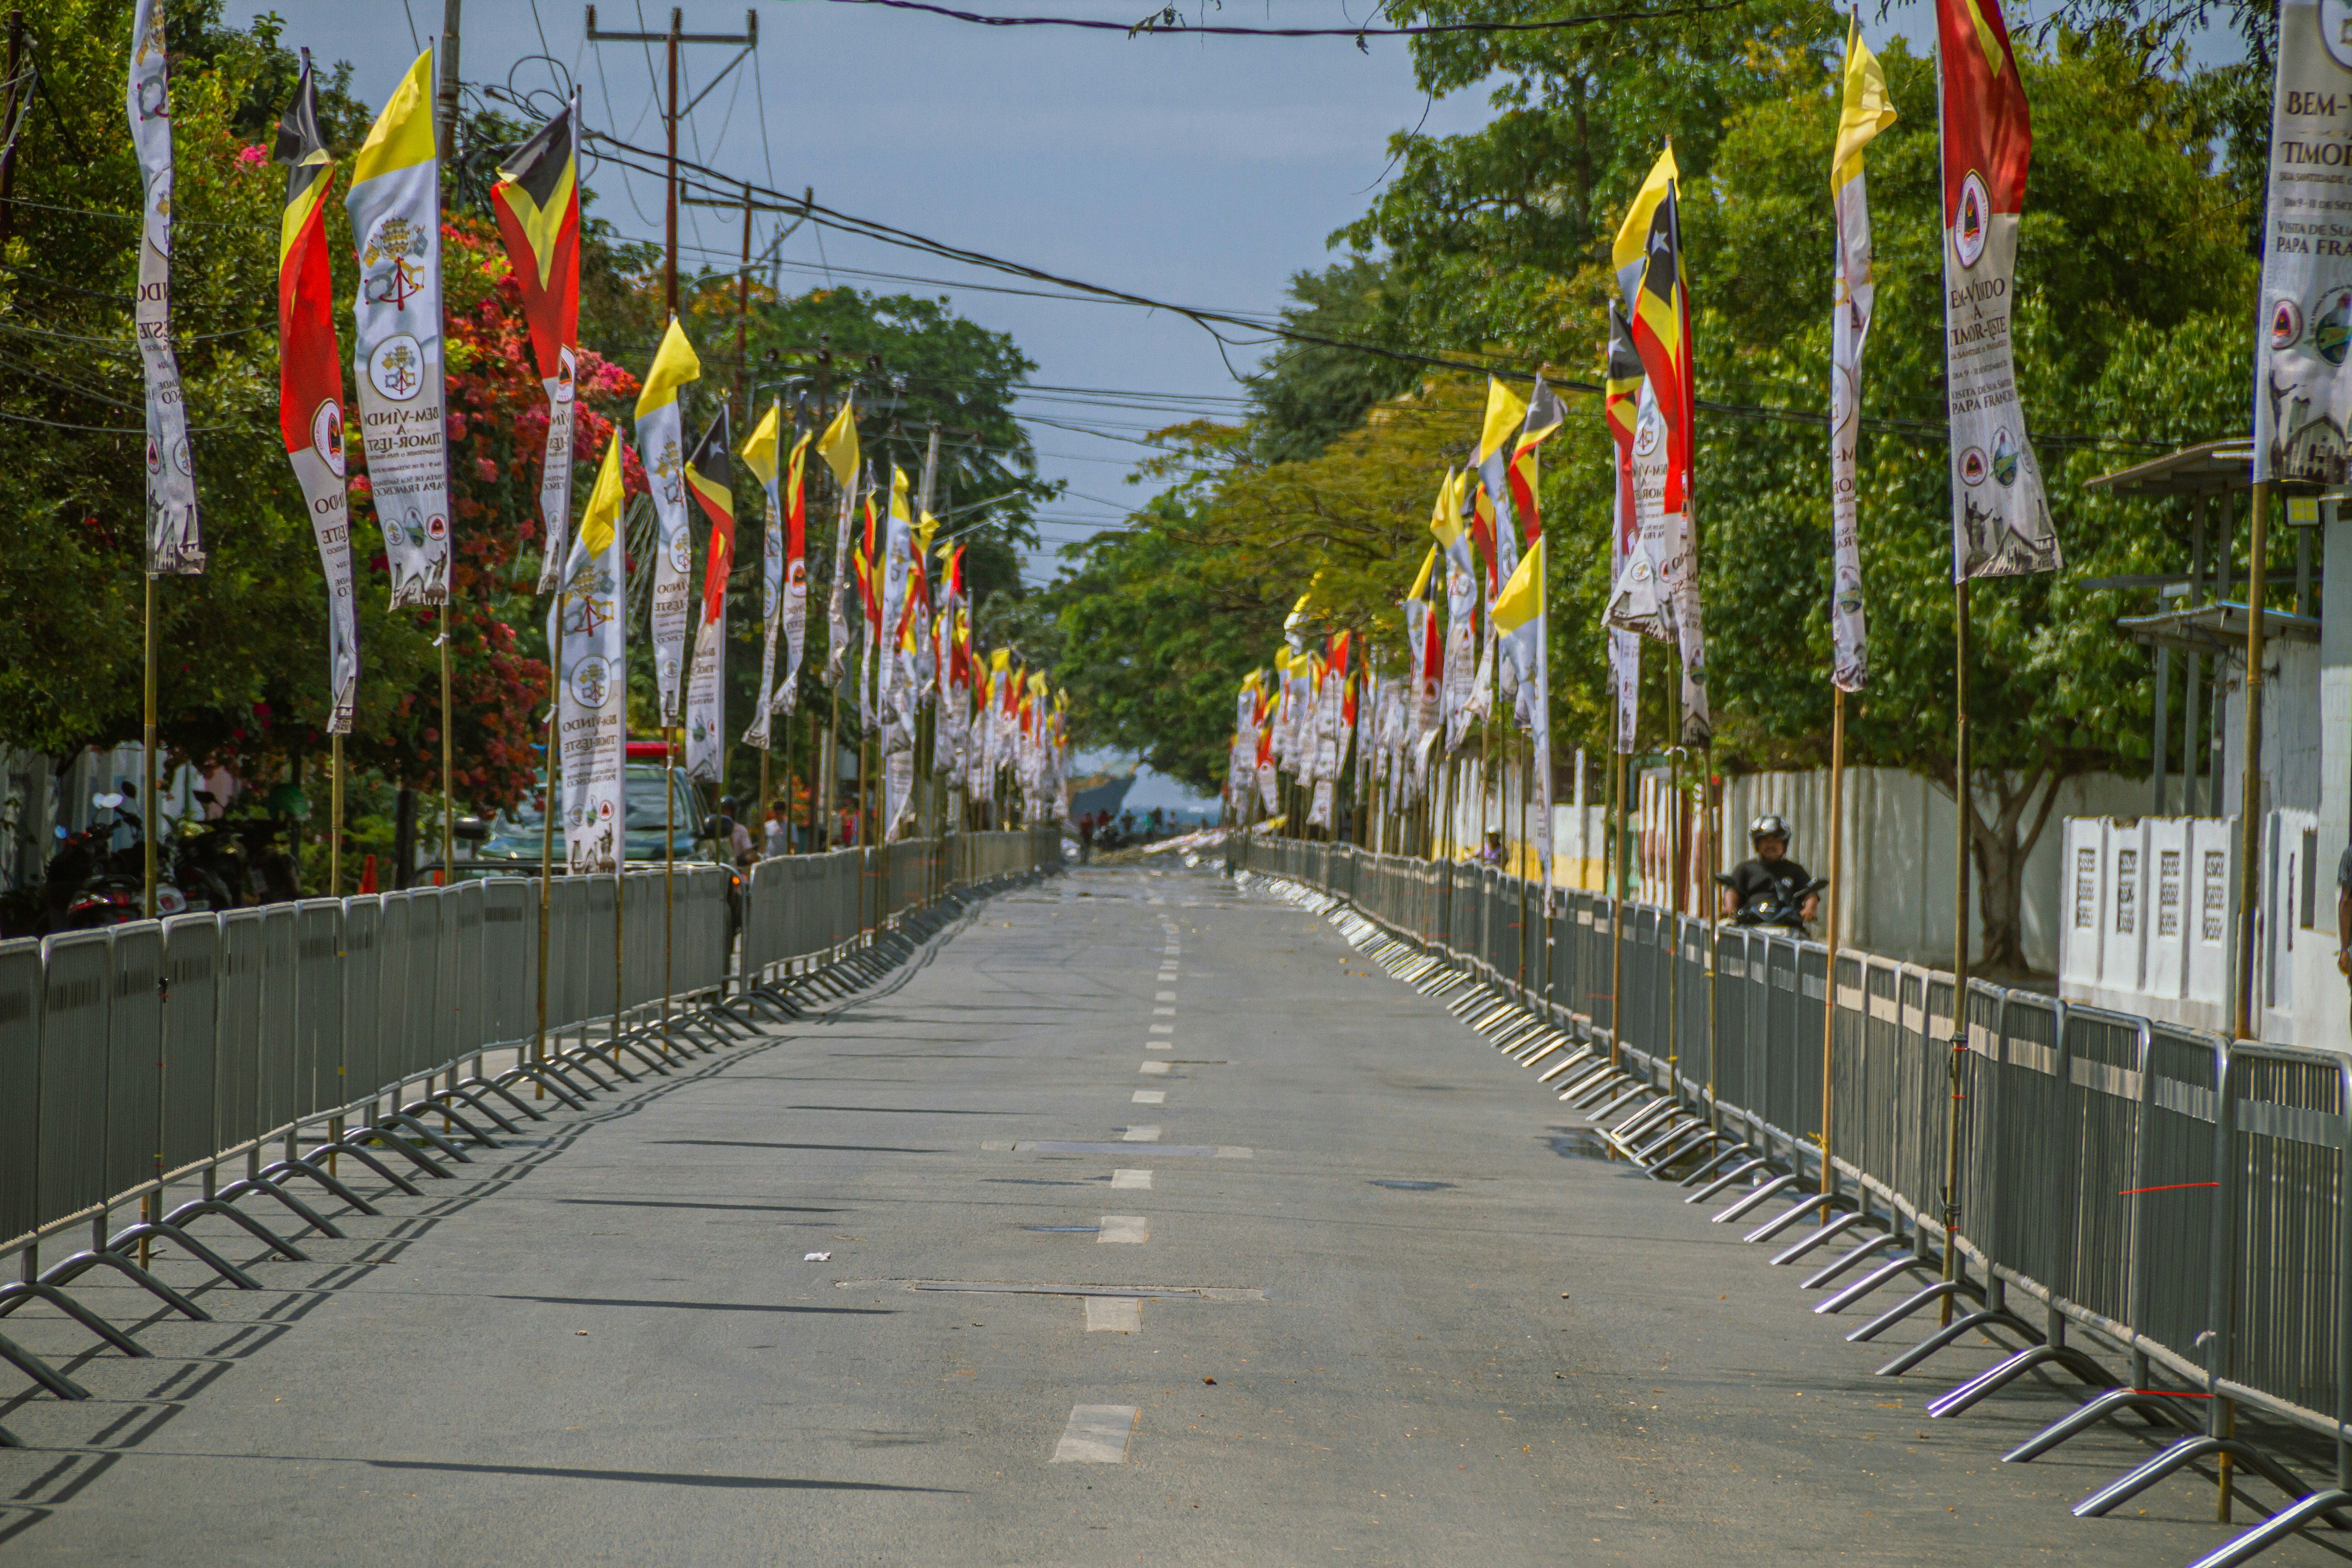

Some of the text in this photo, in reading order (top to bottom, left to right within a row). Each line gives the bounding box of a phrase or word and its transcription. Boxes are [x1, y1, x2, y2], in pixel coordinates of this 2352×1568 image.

[2276, 236, 2309, 254] PAPA
[1974, 304, 1983, 320] A
[1952, 399, 1981, 415] PAPA
